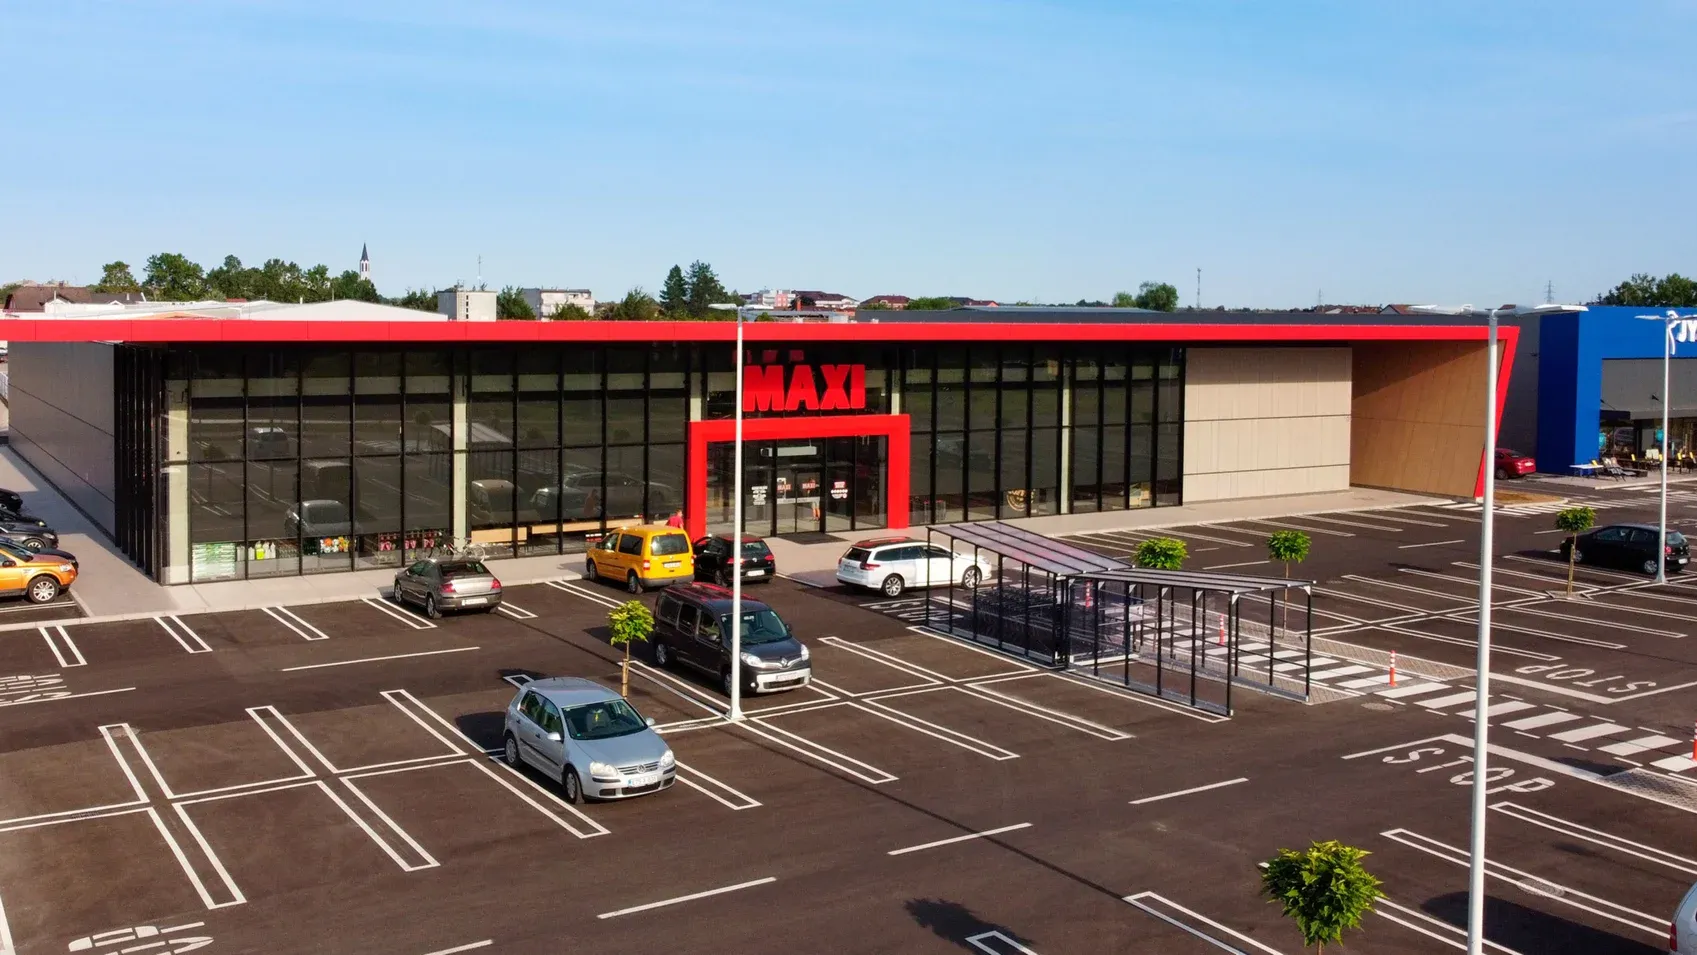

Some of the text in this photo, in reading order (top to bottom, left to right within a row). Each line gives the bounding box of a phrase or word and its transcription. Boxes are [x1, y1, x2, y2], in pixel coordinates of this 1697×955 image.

[743, 364, 866, 412] MAXI
[1515, 664, 1657, 693] STOP
[1382, 747, 1556, 793] STOP
